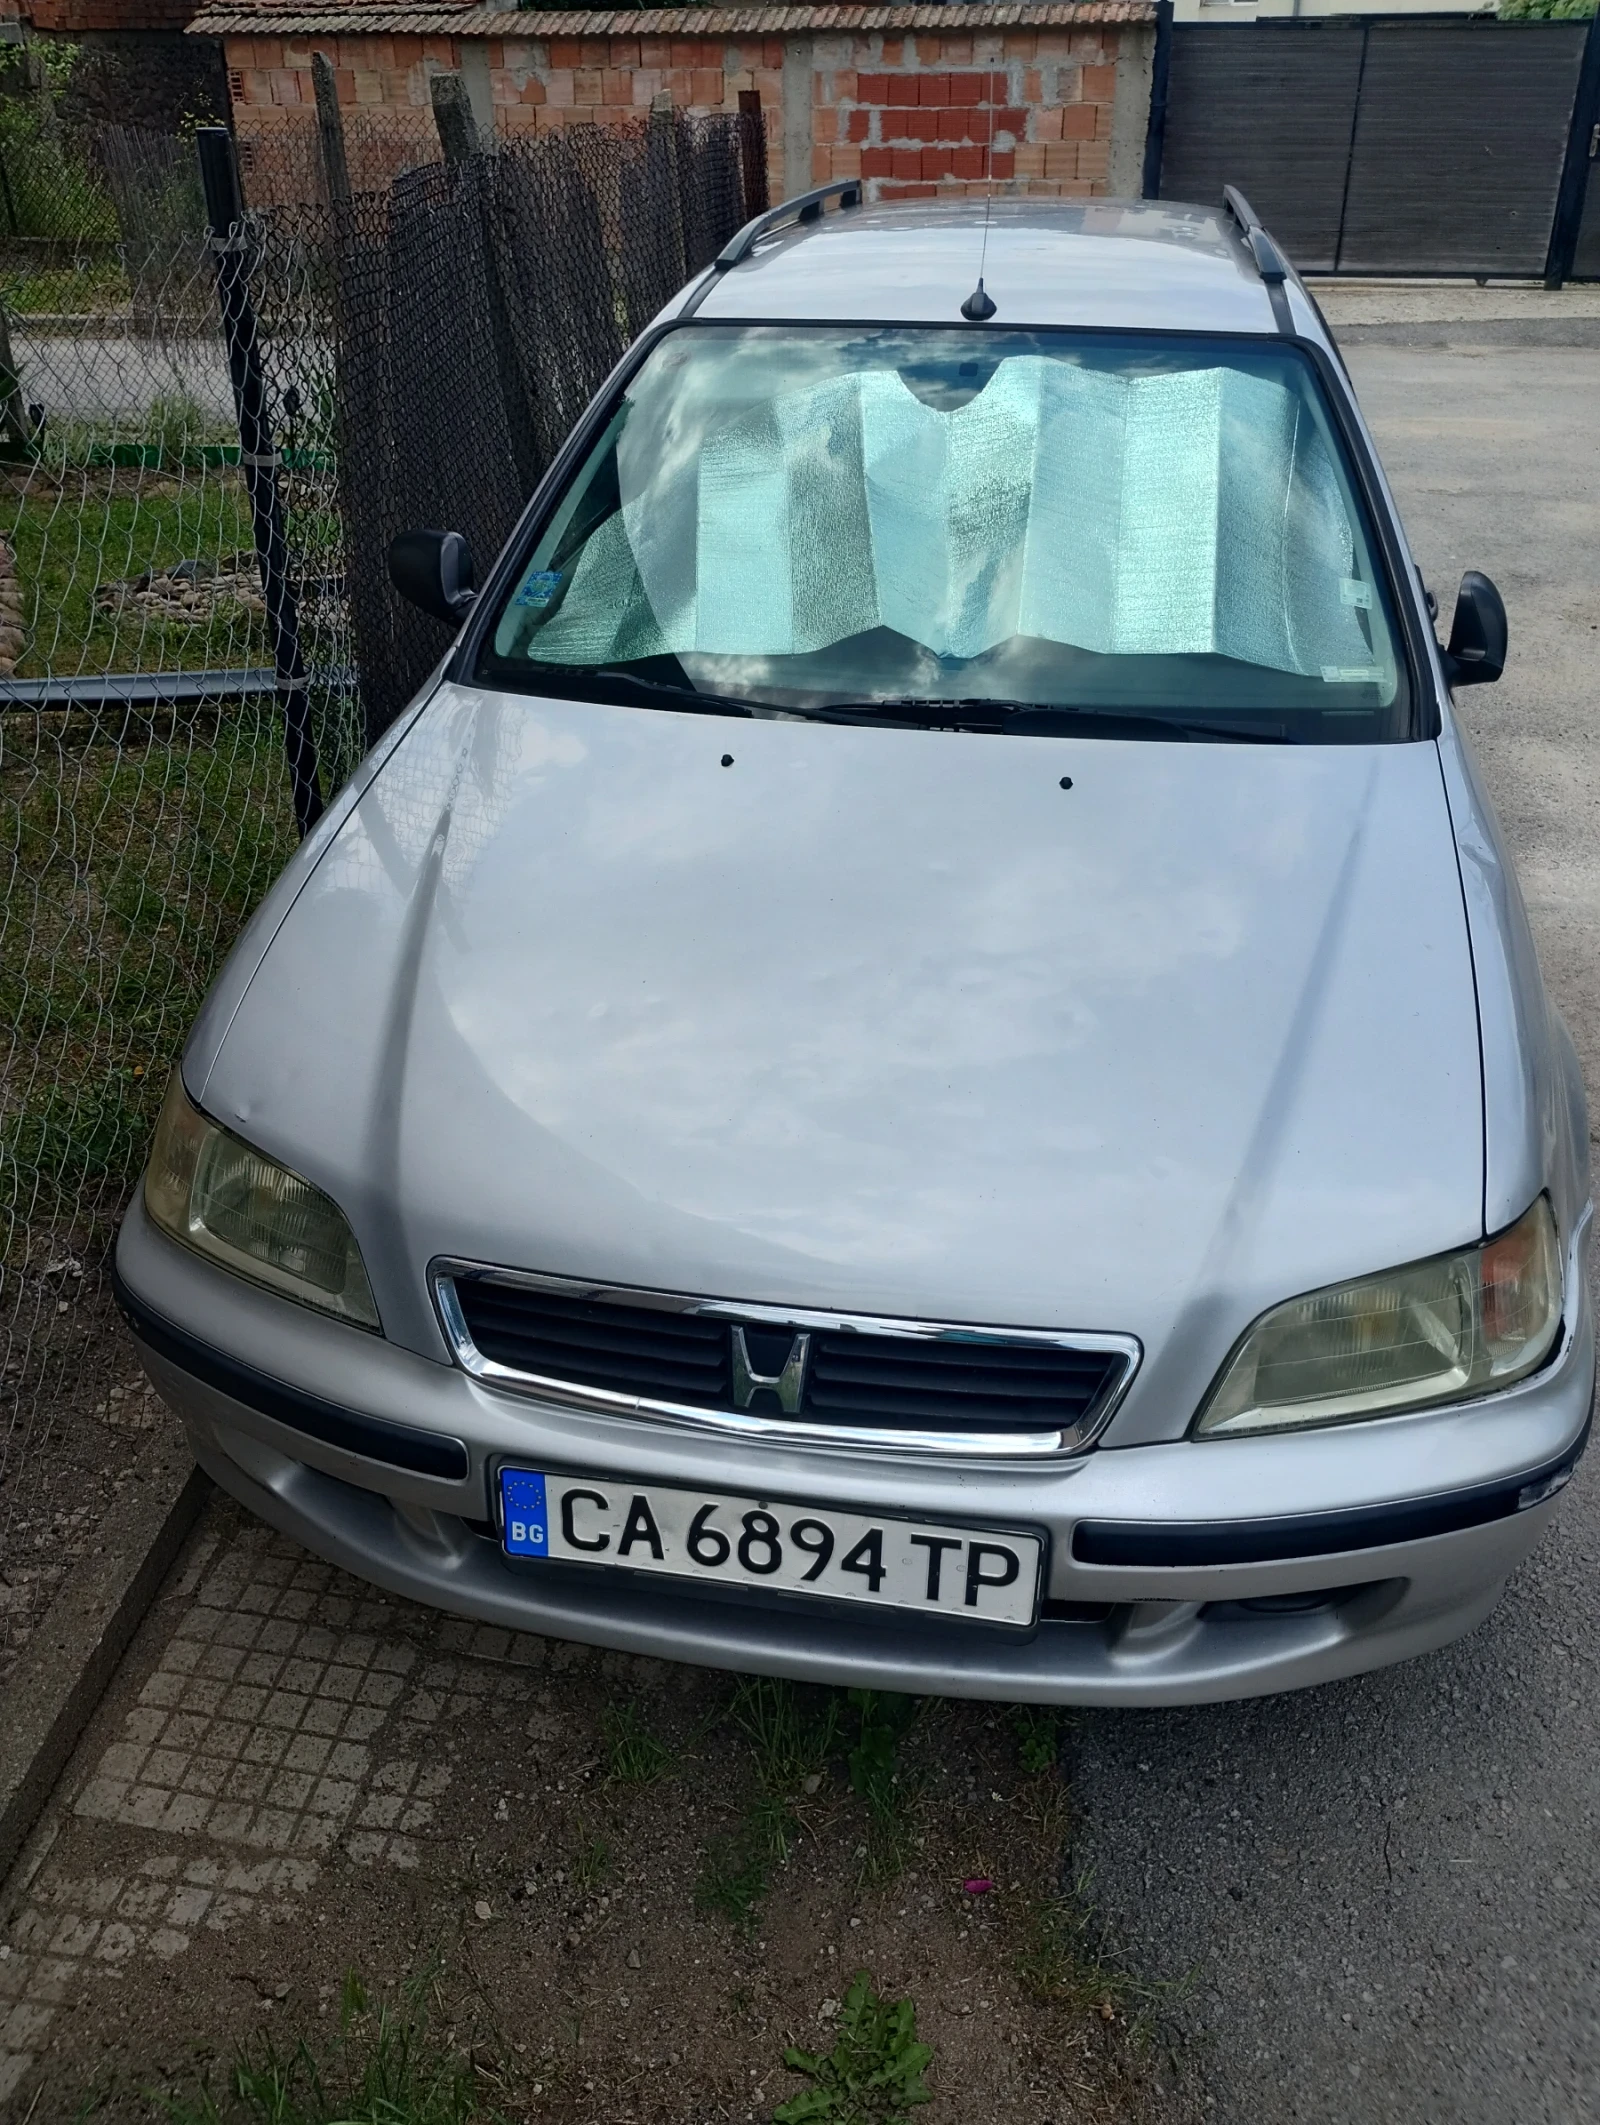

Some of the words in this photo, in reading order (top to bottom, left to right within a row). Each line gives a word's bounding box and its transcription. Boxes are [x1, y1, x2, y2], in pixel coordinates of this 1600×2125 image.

[511, 1521, 544, 1544] BG
[561, 1487, 665, 1560] CA
[687, 1503, 887, 1592] 6894
[910, 1533, 1020, 1606] TP
